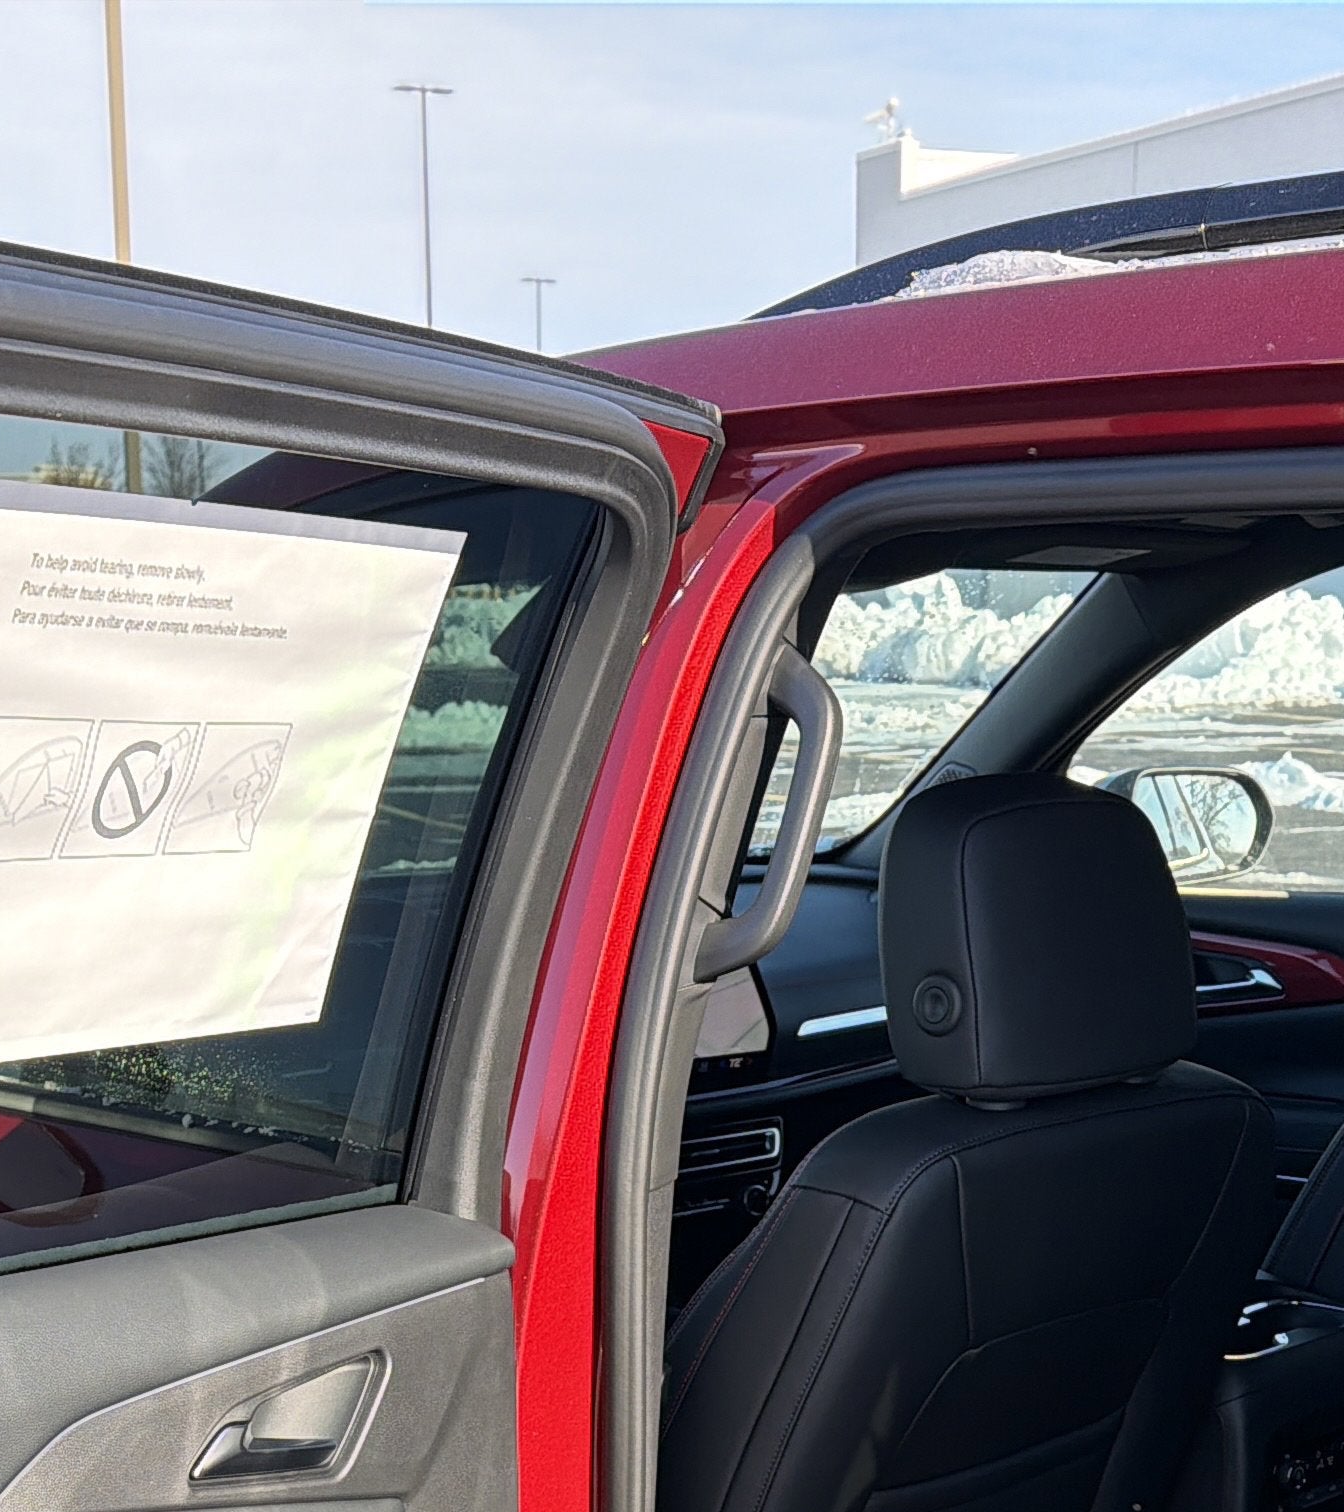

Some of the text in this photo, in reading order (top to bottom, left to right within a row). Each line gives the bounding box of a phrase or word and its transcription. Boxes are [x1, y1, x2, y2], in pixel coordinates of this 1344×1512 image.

[31, 552, 205, 585] To help avoid tearing, remove slowly.
[20, 579, 46, 597] Pour
[47, 582, 78, 600] éviter
[79, 585, 106, 602] toute
[11, 608, 36, 625] Para
[37, 610, 85, 629] ayudarse
[86, 615, 94, 628] a
[95, 614, 124, 629] evitar
[124, 618, 144, 634] que
[144, 620, 157, 632] se
